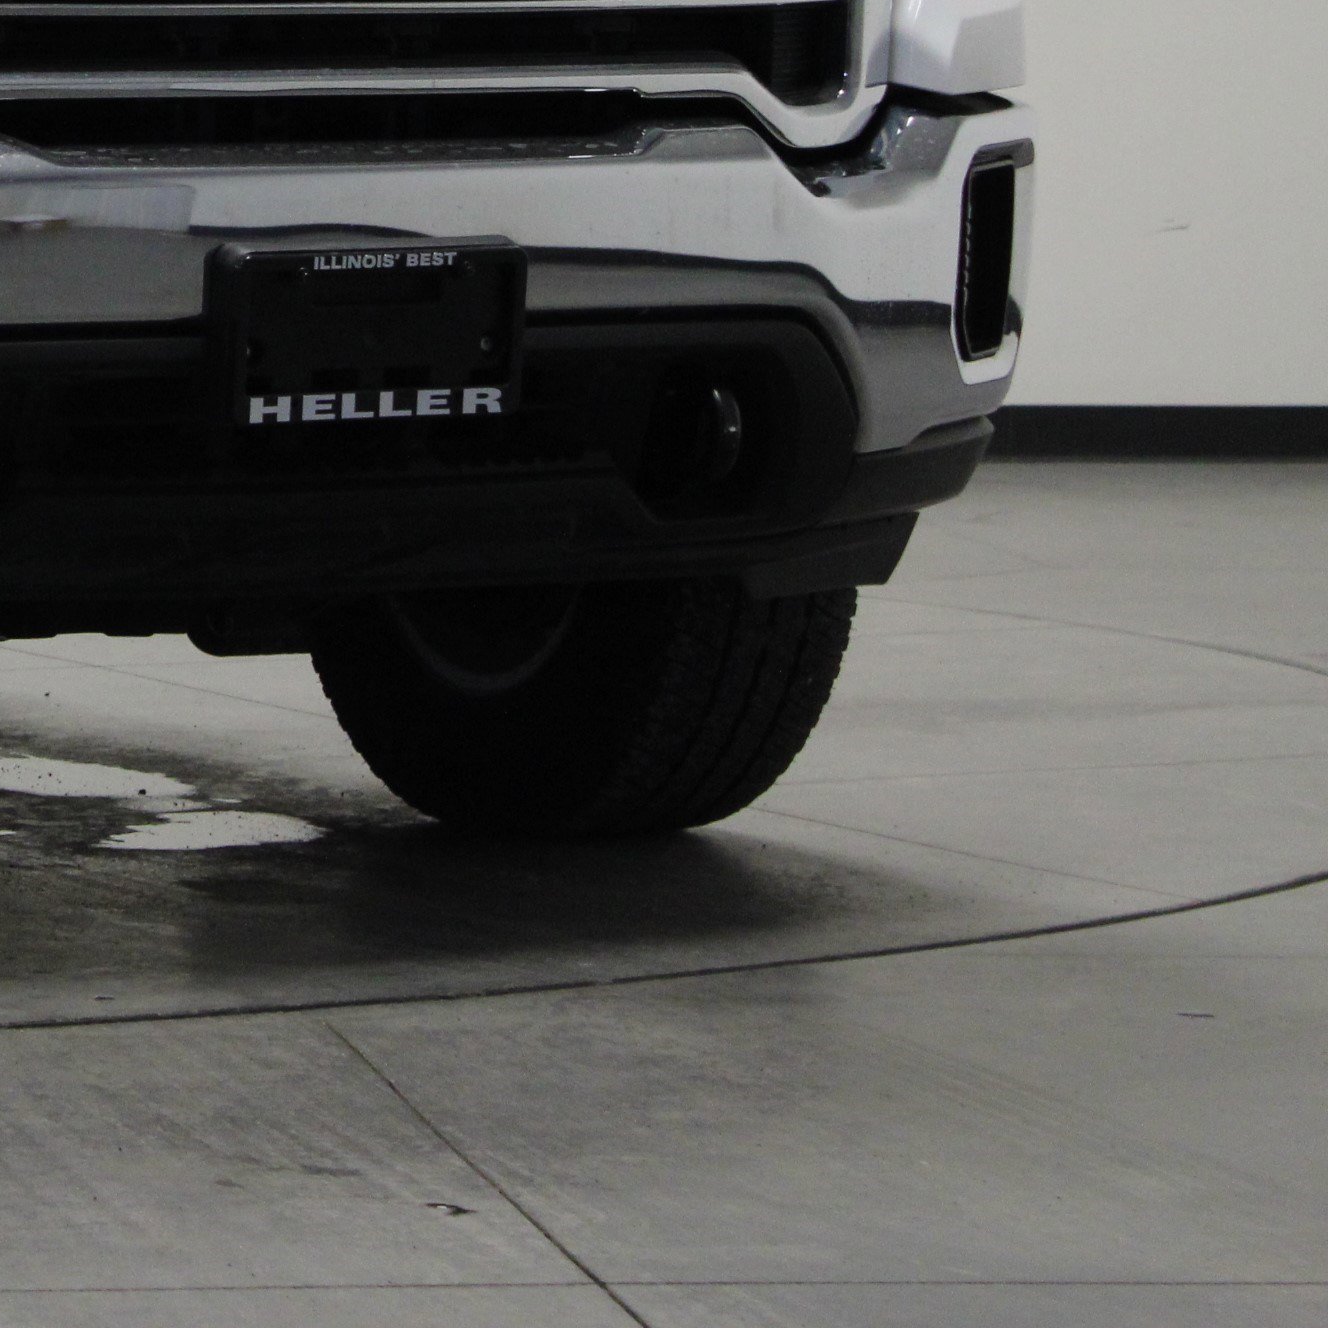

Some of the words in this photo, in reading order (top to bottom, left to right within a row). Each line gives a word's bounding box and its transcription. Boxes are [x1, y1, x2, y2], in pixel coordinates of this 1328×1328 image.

[314, 253, 400, 271] ILLINOIS'
[406, 250, 458, 268] BEST
[248, 386, 503, 424] HELLER
